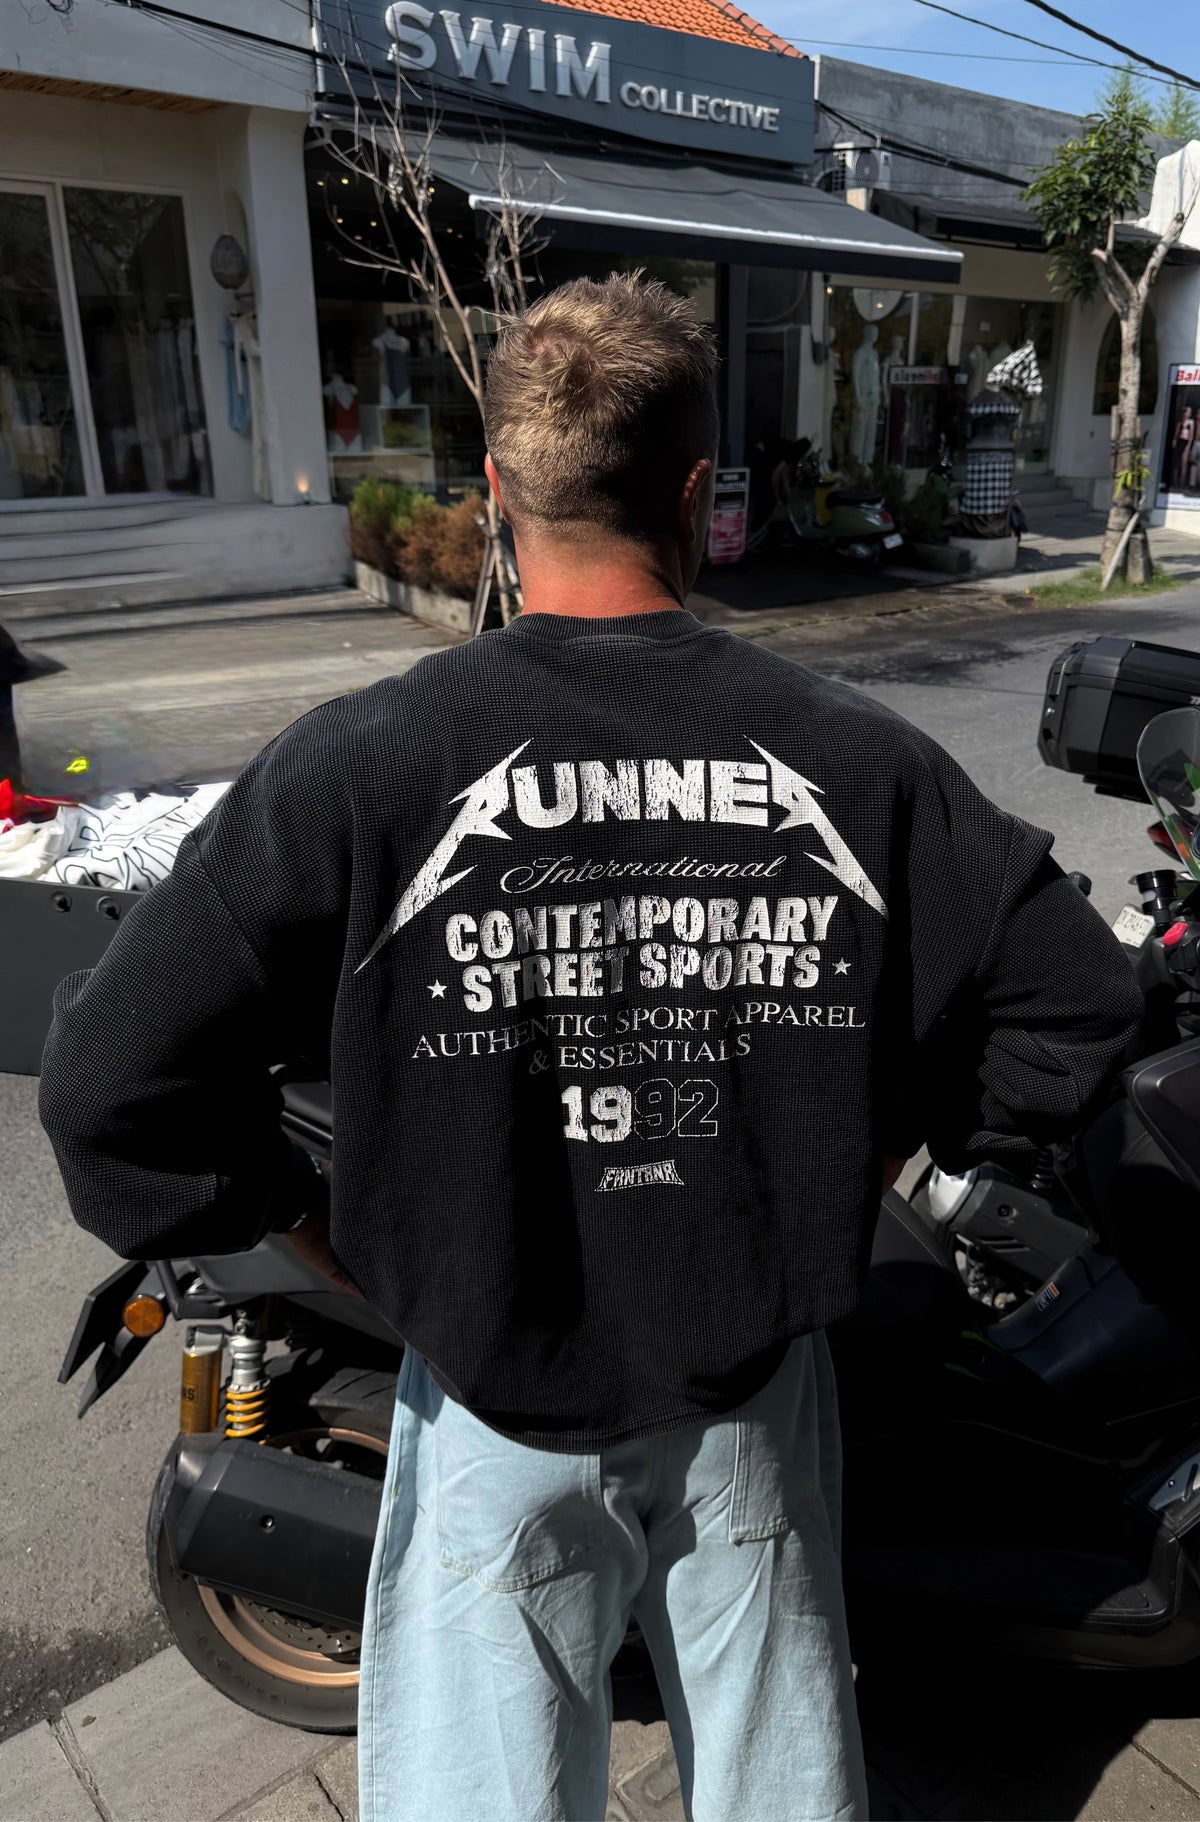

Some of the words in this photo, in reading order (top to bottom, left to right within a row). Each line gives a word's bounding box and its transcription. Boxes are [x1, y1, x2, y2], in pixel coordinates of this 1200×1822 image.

[384, 1, 612, 104] SWIM
[620, 80, 781, 133] COLLECTIVE
[1175, 368, 1200, 382] Bal
[354, 735, 890, 974] RUNNER
[500, 855, 787, 894] International
[445, 895, 839, 962] CONTEMPORARY
[462, 947, 630, 1013] STREET
[639, 942, 821, 991] SPORTS
[411, 1014, 607, 1059] AUTHENTIC
[615, 1006, 718, 1034] SPORT
[724, 1001, 867, 1029] APPAREL
[528, 1049, 551, 1075] &
[558, 1033, 751, 1070] ESSENTIALS
[561, 1078, 719, 1143] 1992
